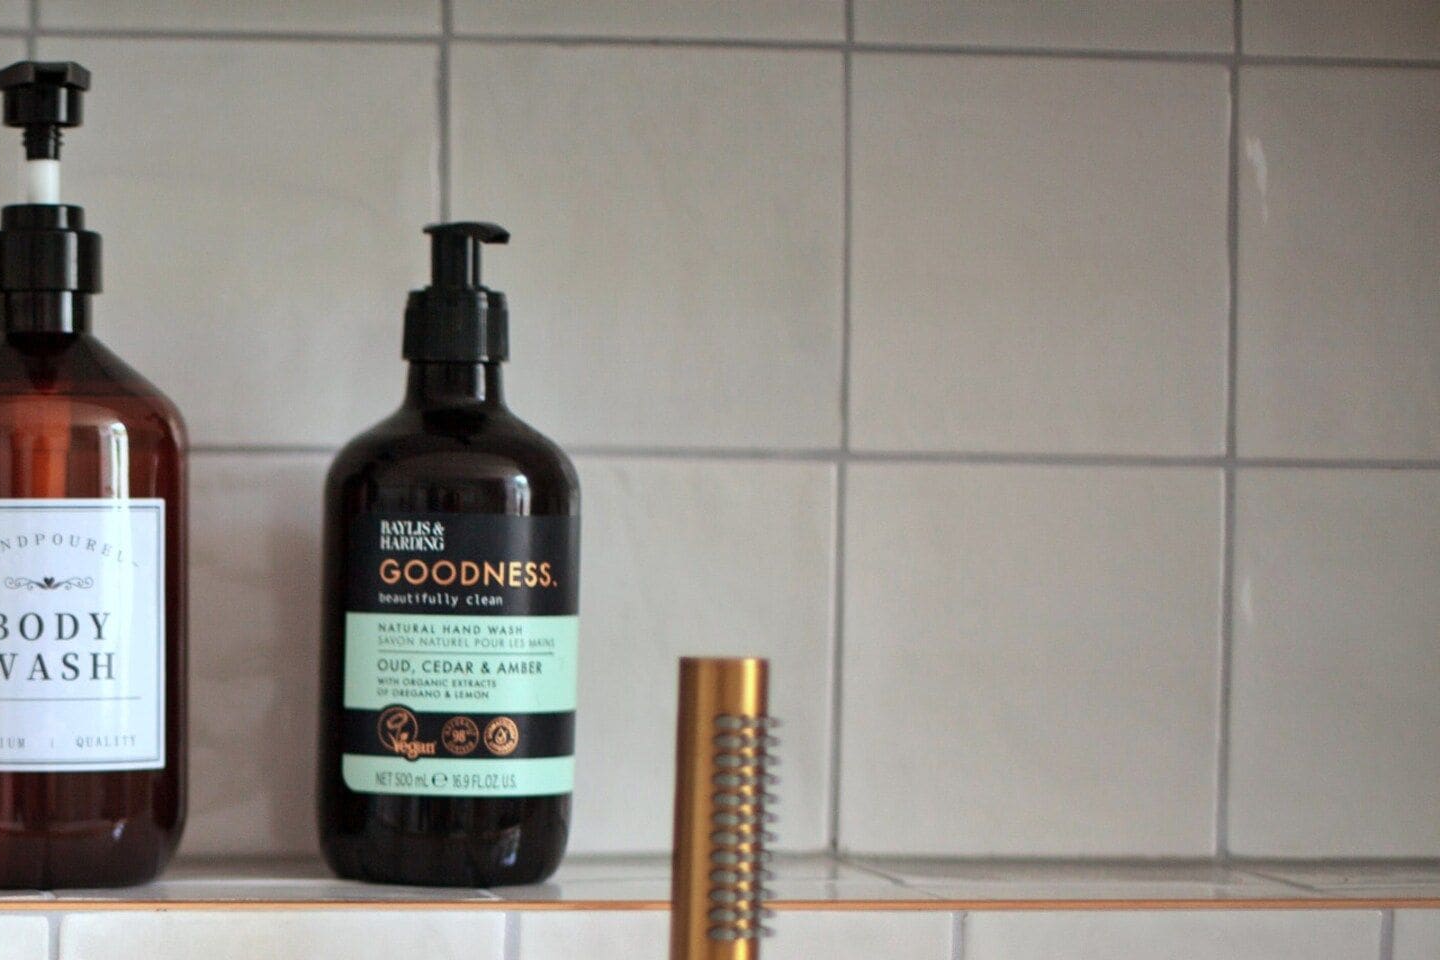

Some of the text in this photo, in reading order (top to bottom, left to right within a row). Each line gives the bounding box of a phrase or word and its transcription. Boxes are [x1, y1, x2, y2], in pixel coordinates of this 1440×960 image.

[380, 519, 445, 536] BAYLIS &
[380, 535, 445, 551] HARDING
[378, 592, 504, 608] beautifully clean
[378, 623, 523, 636] NATURAL HAND WASH
[378, 636, 556, 649] SAVON NATUREL POUR LES MAINS
[377, 658, 543, 675] OUD, CEDAR & AMBER
[377, 677, 497, 688] WITH ORGANIC EXTRACTS
[377, 688, 389, 697] OF
[392, 689, 441, 699] OREGANO
[454, 690, 489, 699] LEMON
[75, 735, 137, 749] QUALITY
[376, 771, 393, 786] NET
[395, 772, 413, 787] 500
